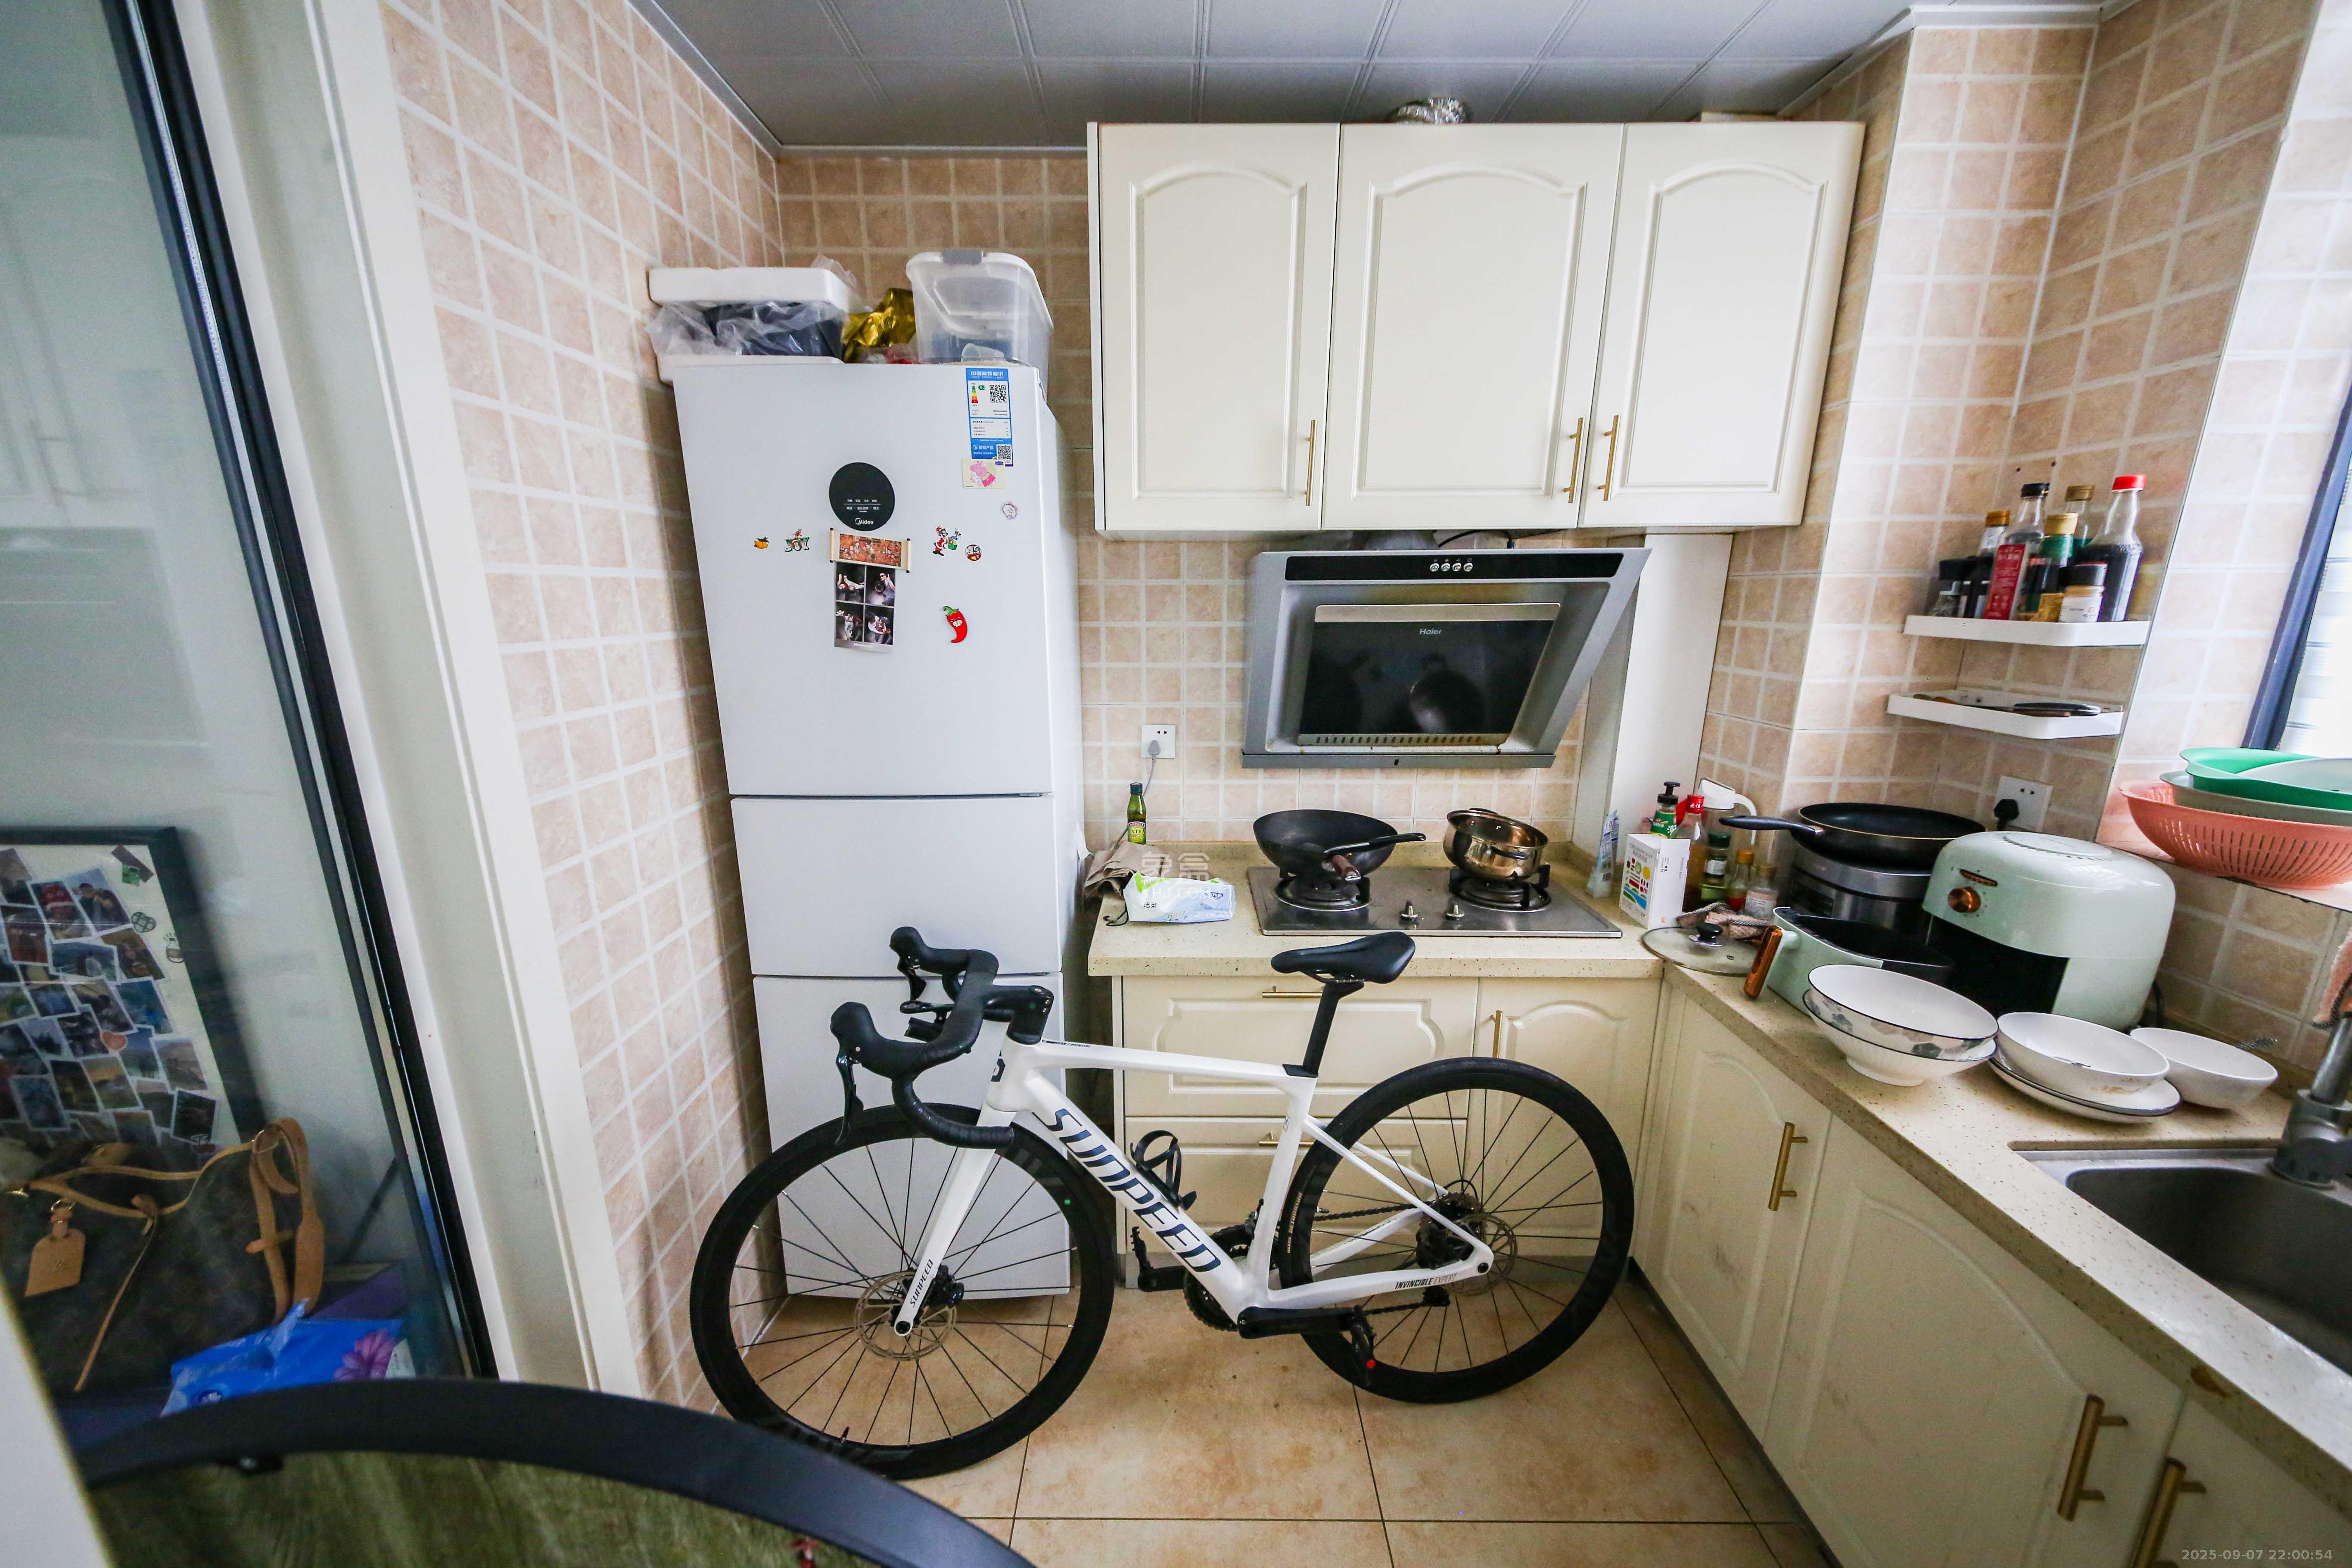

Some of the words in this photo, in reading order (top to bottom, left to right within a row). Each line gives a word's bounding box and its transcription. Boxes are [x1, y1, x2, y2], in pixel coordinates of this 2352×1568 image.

[1032, 1108, 1221, 1272] SUNPEED
[910, 1259, 933, 1308] SUNPEED
[1395, 1278, 1434, 1289] INVINCIBLE
[1433, 1272, 1458, 1285] EXPERT
